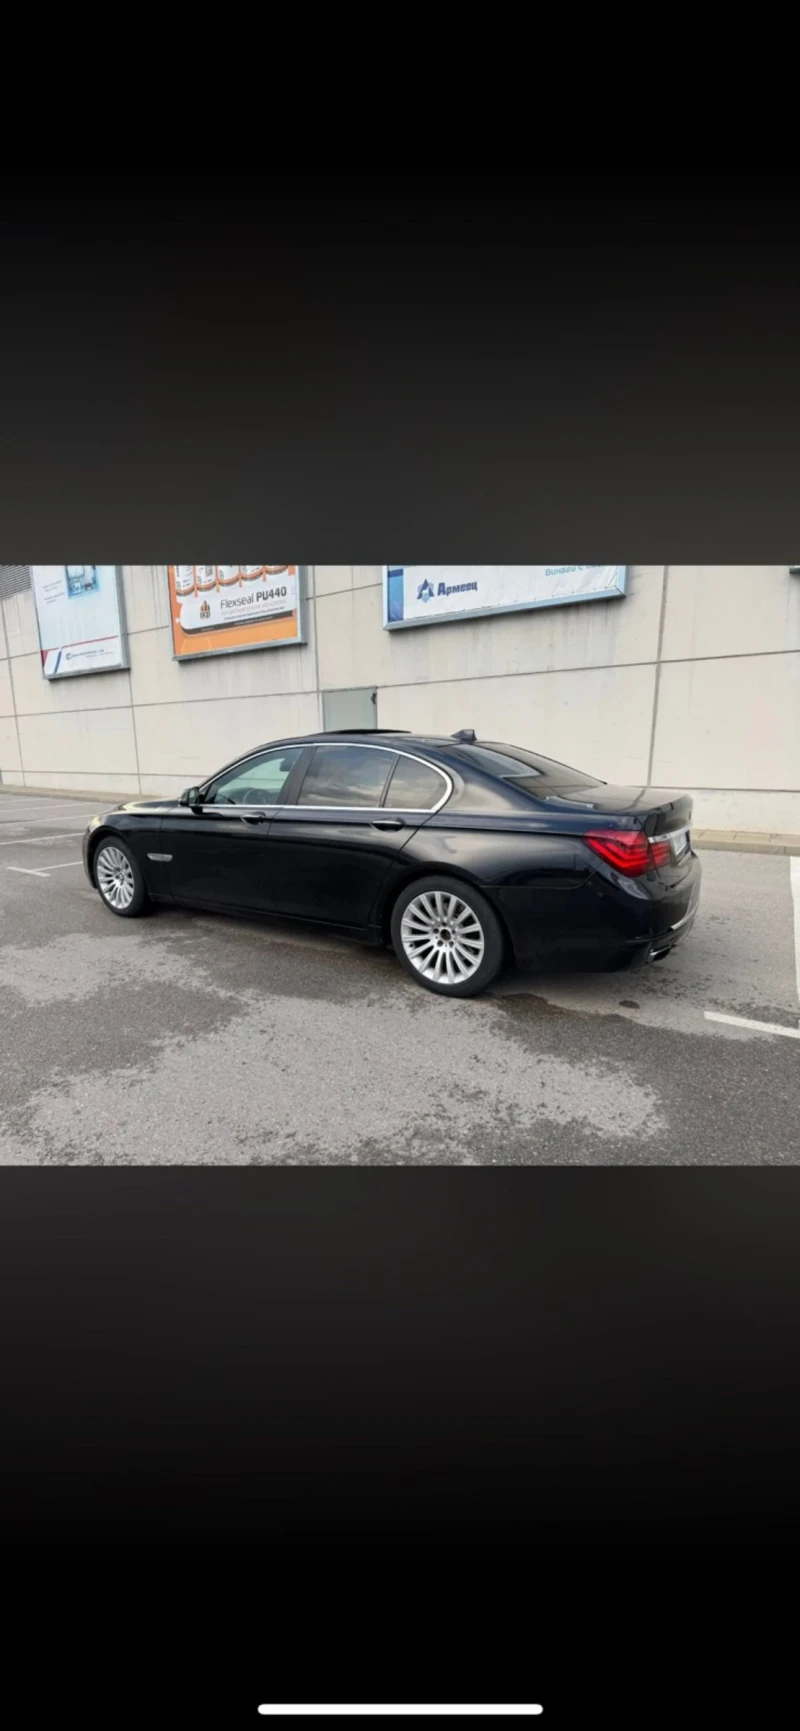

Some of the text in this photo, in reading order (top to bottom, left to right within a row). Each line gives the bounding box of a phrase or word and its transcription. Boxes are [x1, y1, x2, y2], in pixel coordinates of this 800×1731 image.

[220, 594, 254, 609] Flexseal
[256, 586, 287, 602] PU440
[437, 581, 478, 596] Армеец
